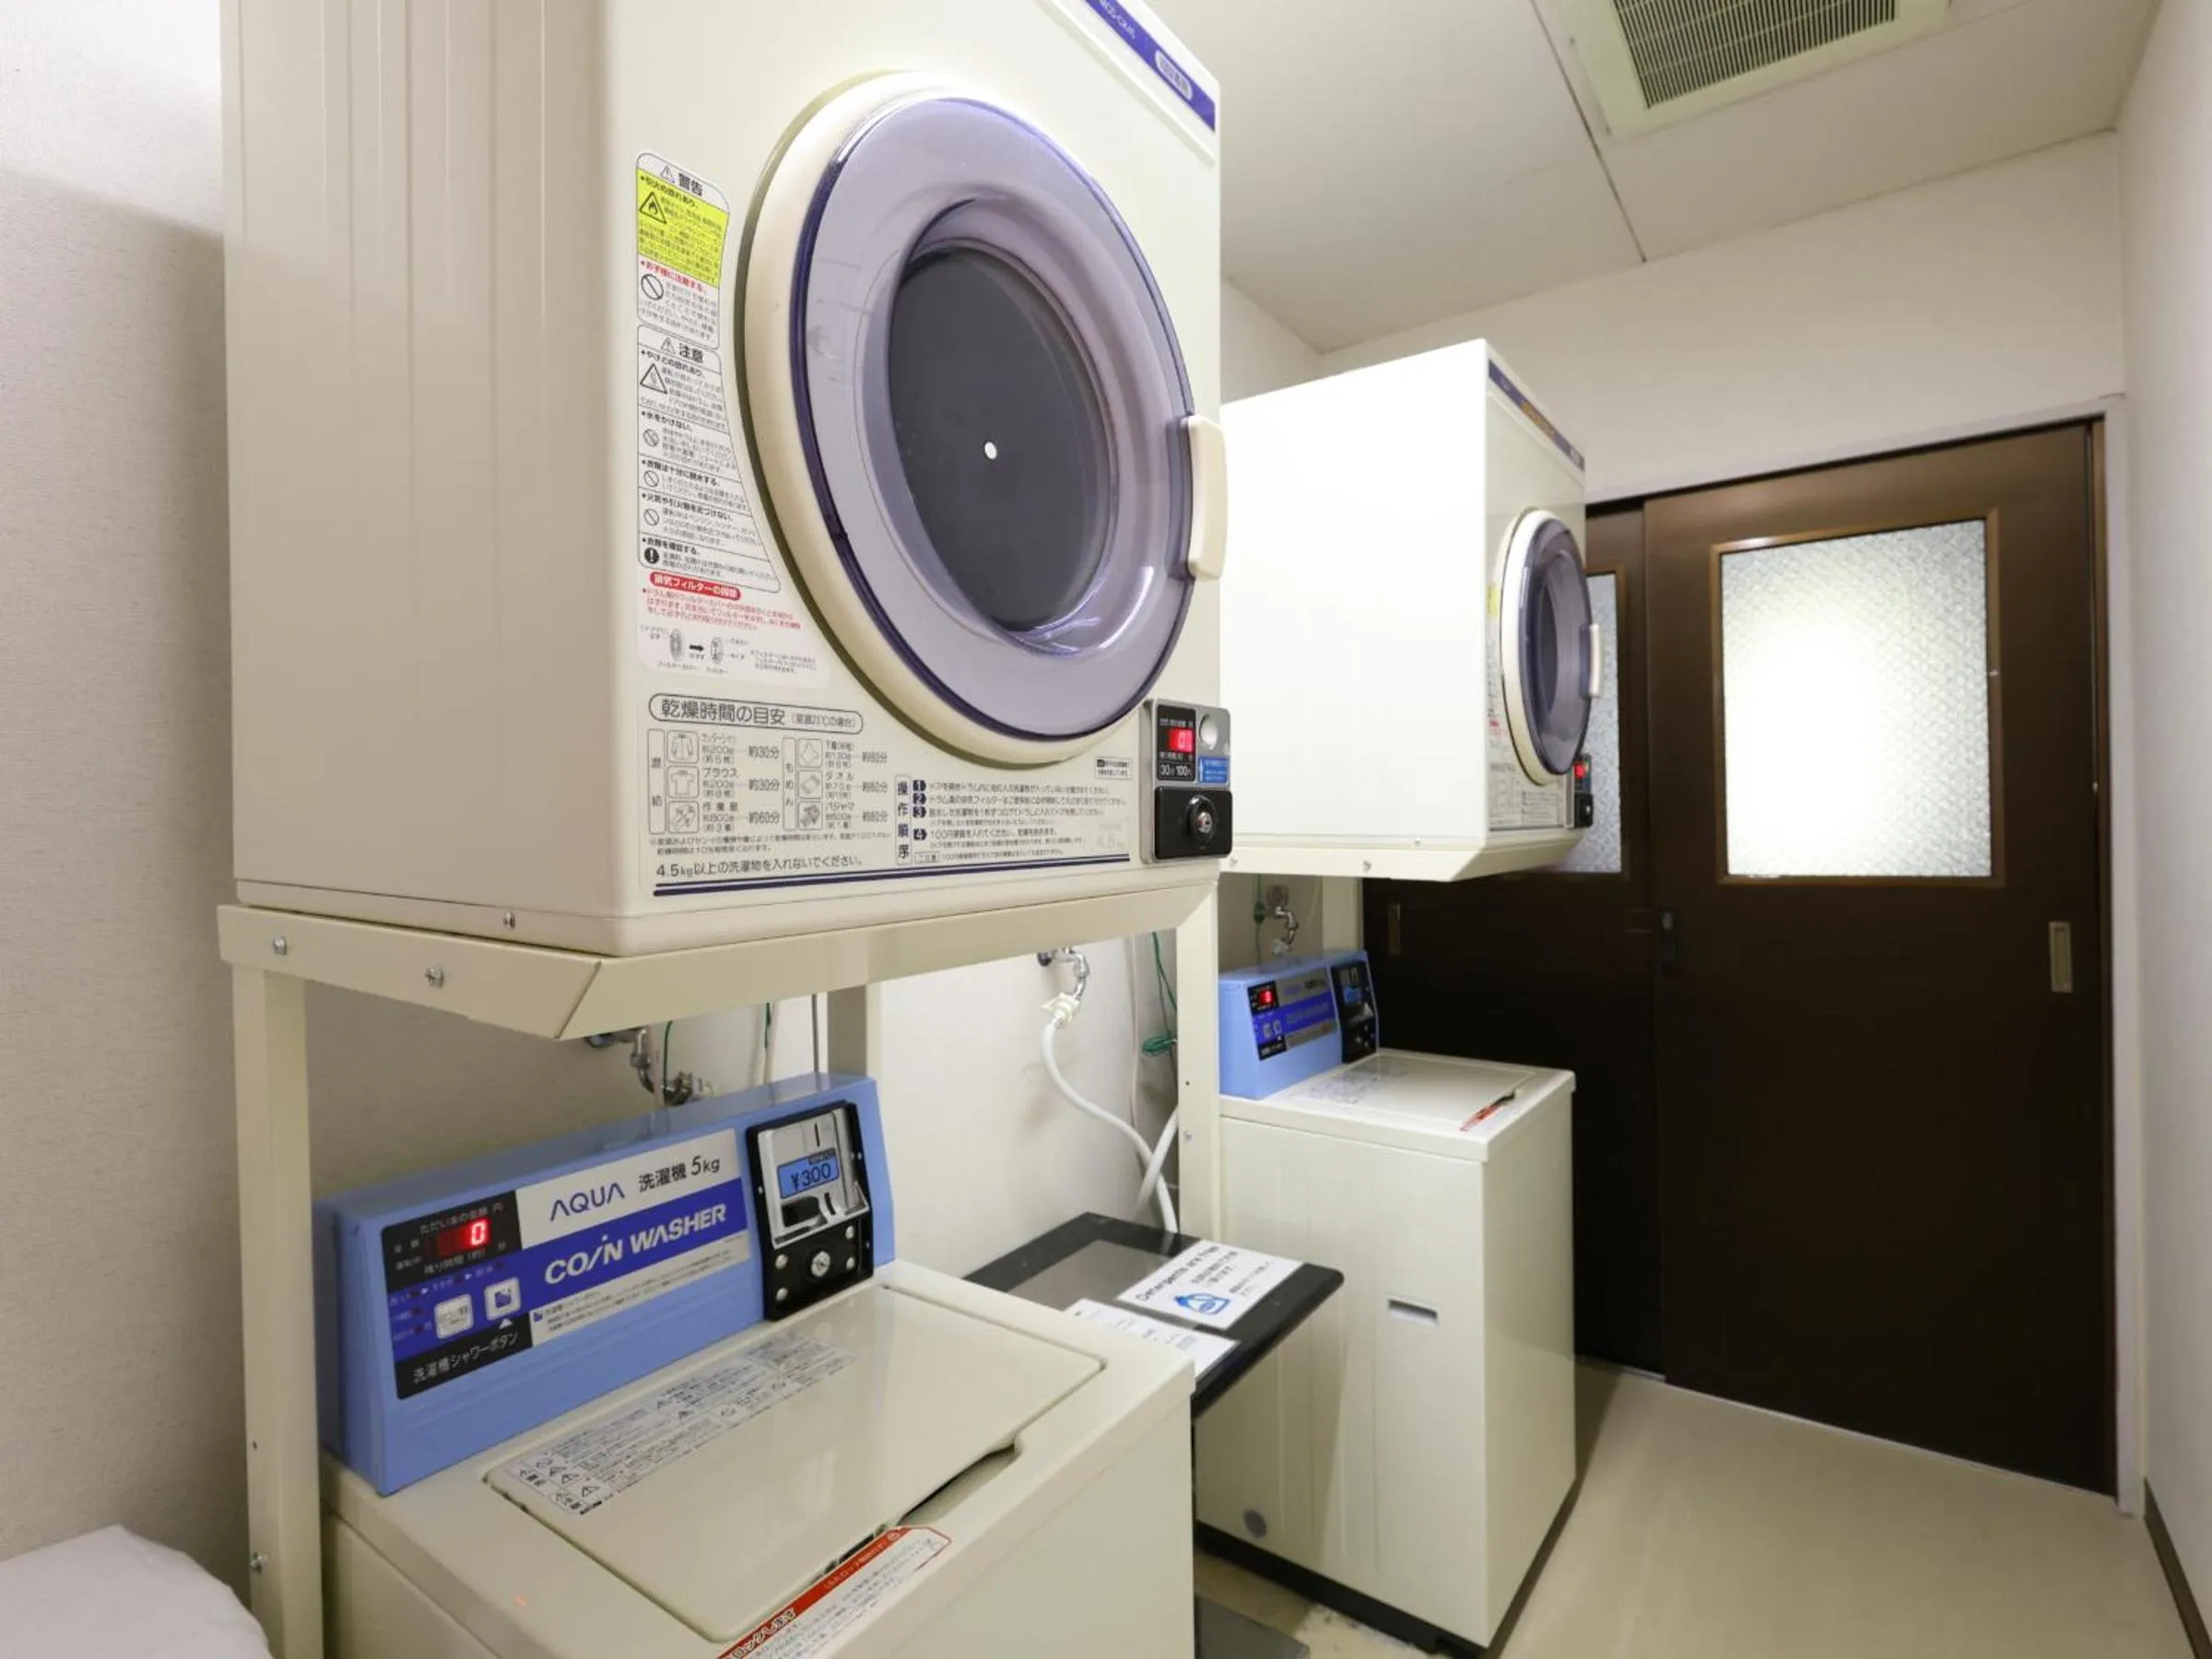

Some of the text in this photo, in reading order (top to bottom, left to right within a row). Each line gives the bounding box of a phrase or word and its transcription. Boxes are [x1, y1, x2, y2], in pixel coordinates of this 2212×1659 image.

[679, 343, 703, 363] 注意
[661, 699, 785, 725] 乾燥時間の目安
[549, 1155, 720, 1222] AQUA 洗濯機 5kg
[790, 1161, 831, 1191] ¥300
[471, 1220, 488, 1246] 0
[544, 1232, 624, 1286] COIN
[629, 1203, 727, 1255] WASHER
